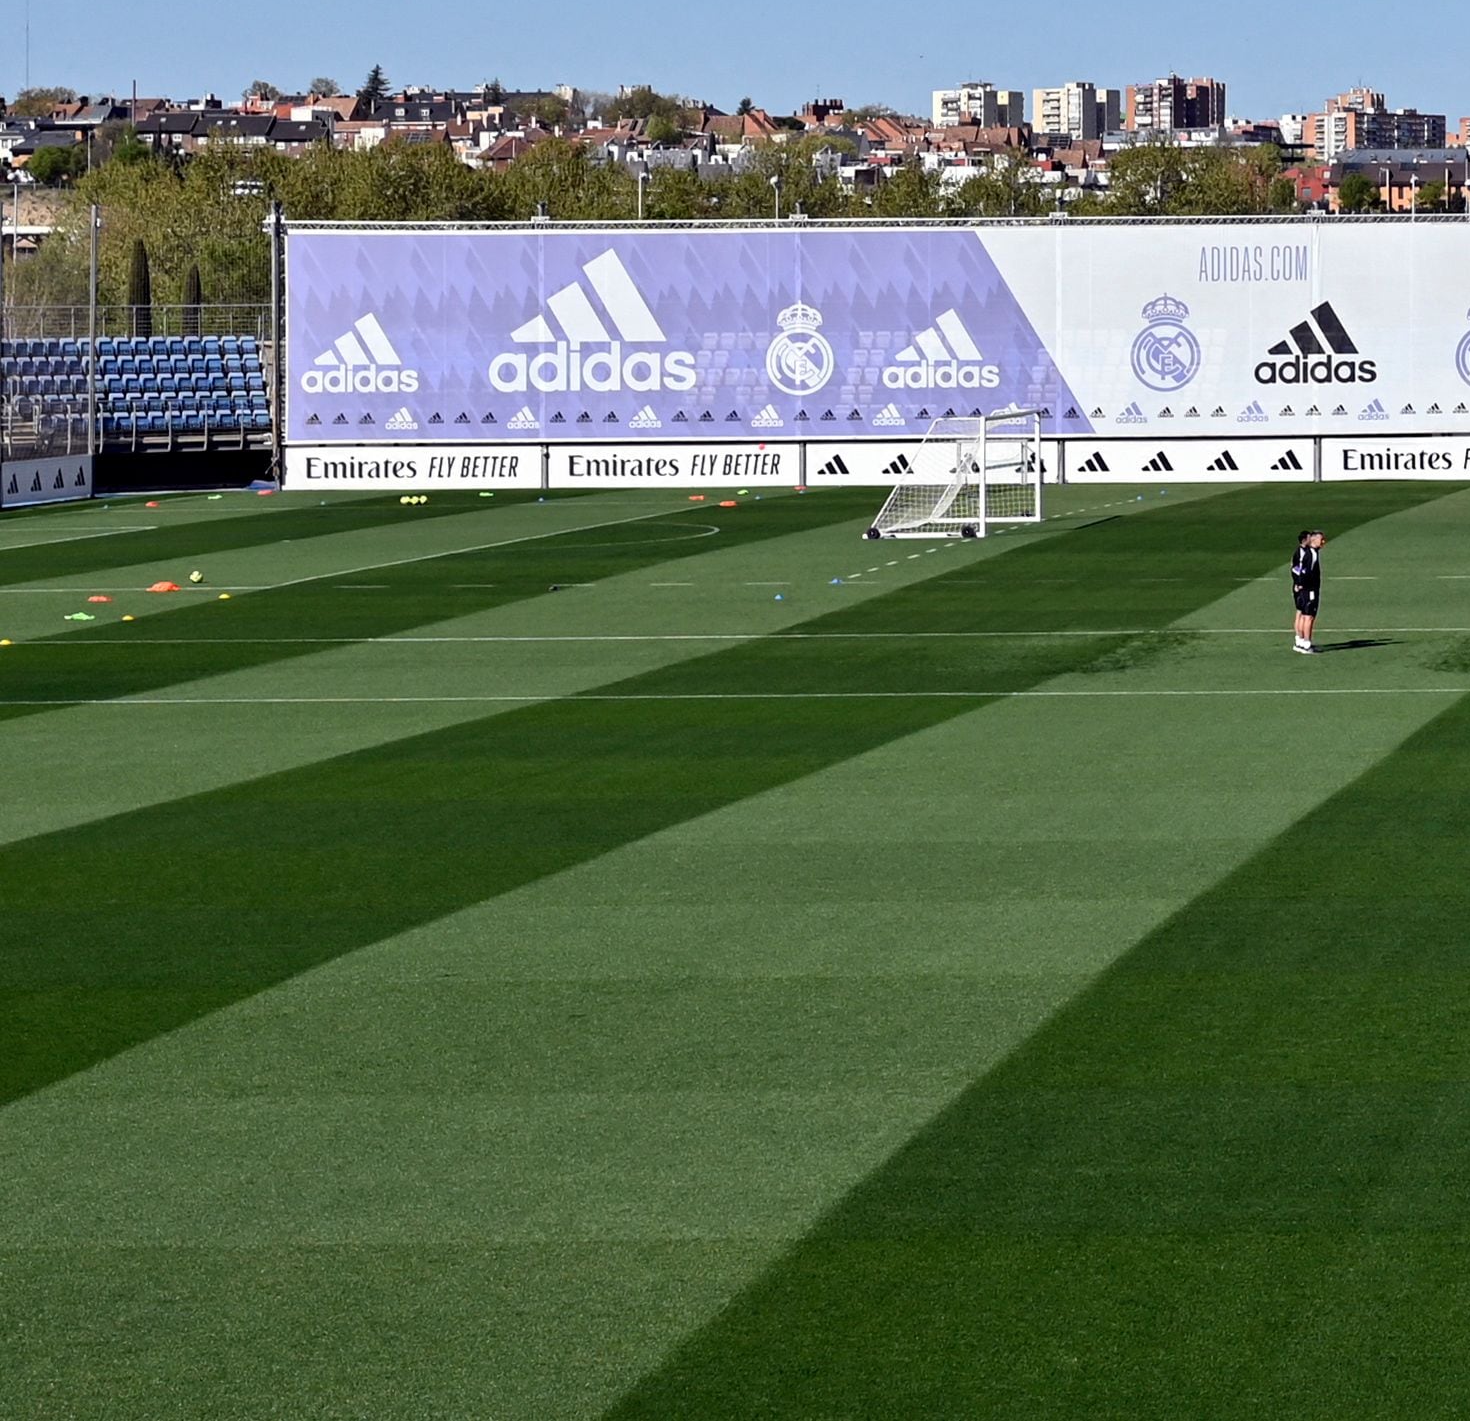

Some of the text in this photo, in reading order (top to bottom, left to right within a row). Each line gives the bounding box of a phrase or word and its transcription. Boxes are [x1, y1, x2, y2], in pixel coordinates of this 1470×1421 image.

[1199, 246, 1307, 281] ADIDAS.COM
[489, 341, 696, 392] adidas
[880, 360, 999, 388] adidas
[1255, 354, 1377, 384] adidas
[301, 364, 418, 393] adidas
[385, 420, 420, 429] adidas
[507, 419, 539, 429] adidas
[629, 419, 661, 428] adidas
[751, 418, 784, 428] adidas
[873, 417, 907, 427] adidas
[1116, 416, 1147, 424] adidas
[1358, 412, 1389, 420] adidas
[306, 456, 518, 478] Emirates FLY BETTER
[569, 452, 780, 476] Emirates FLY BETTER
[1343, 448, 1452, 470] Emirates
